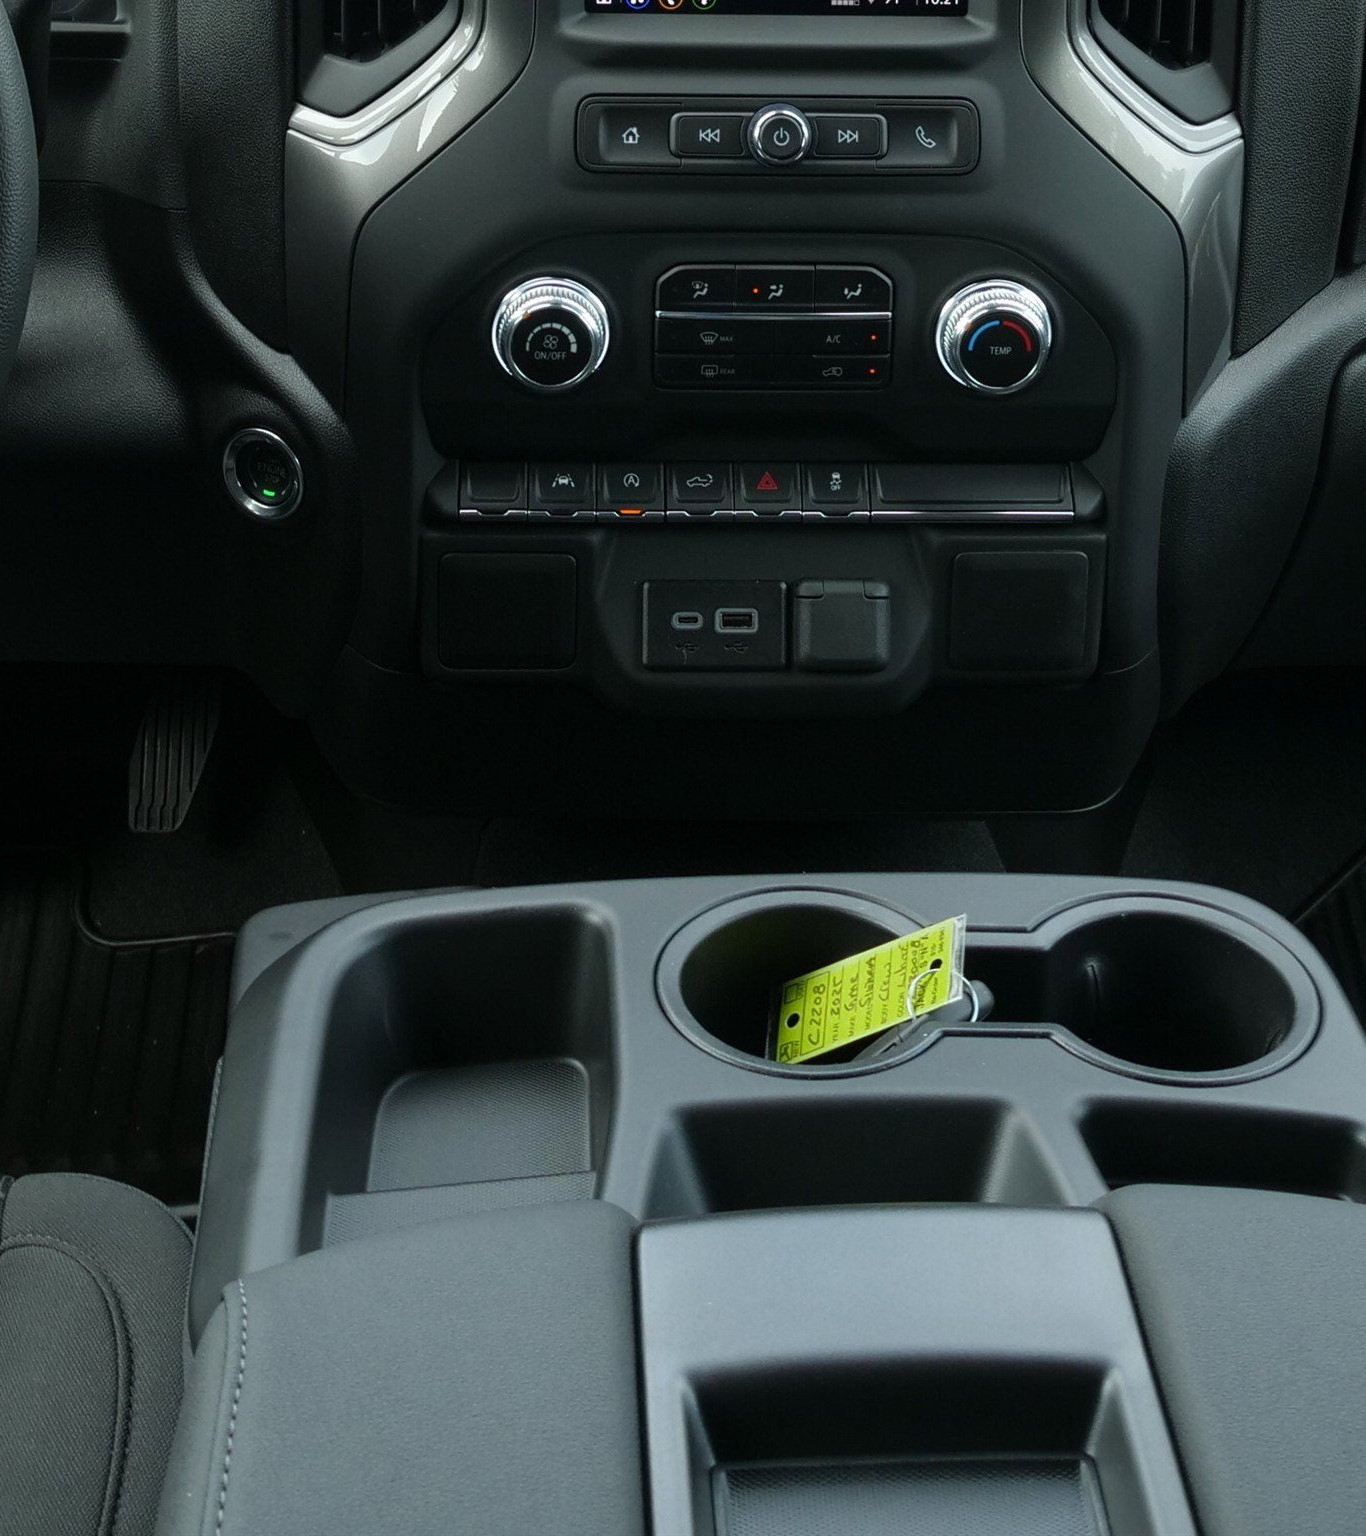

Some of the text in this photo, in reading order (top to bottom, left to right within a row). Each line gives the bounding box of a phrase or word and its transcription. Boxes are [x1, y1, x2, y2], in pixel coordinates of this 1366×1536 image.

[825, 334, 841, 344] A/C
[534, 351, 566, 360] ON/OFF
[990, 346, 1012, 355] TEMP
[830, 975, 843, 1017] 2025
[808, 982, 826, 1046] C2208
